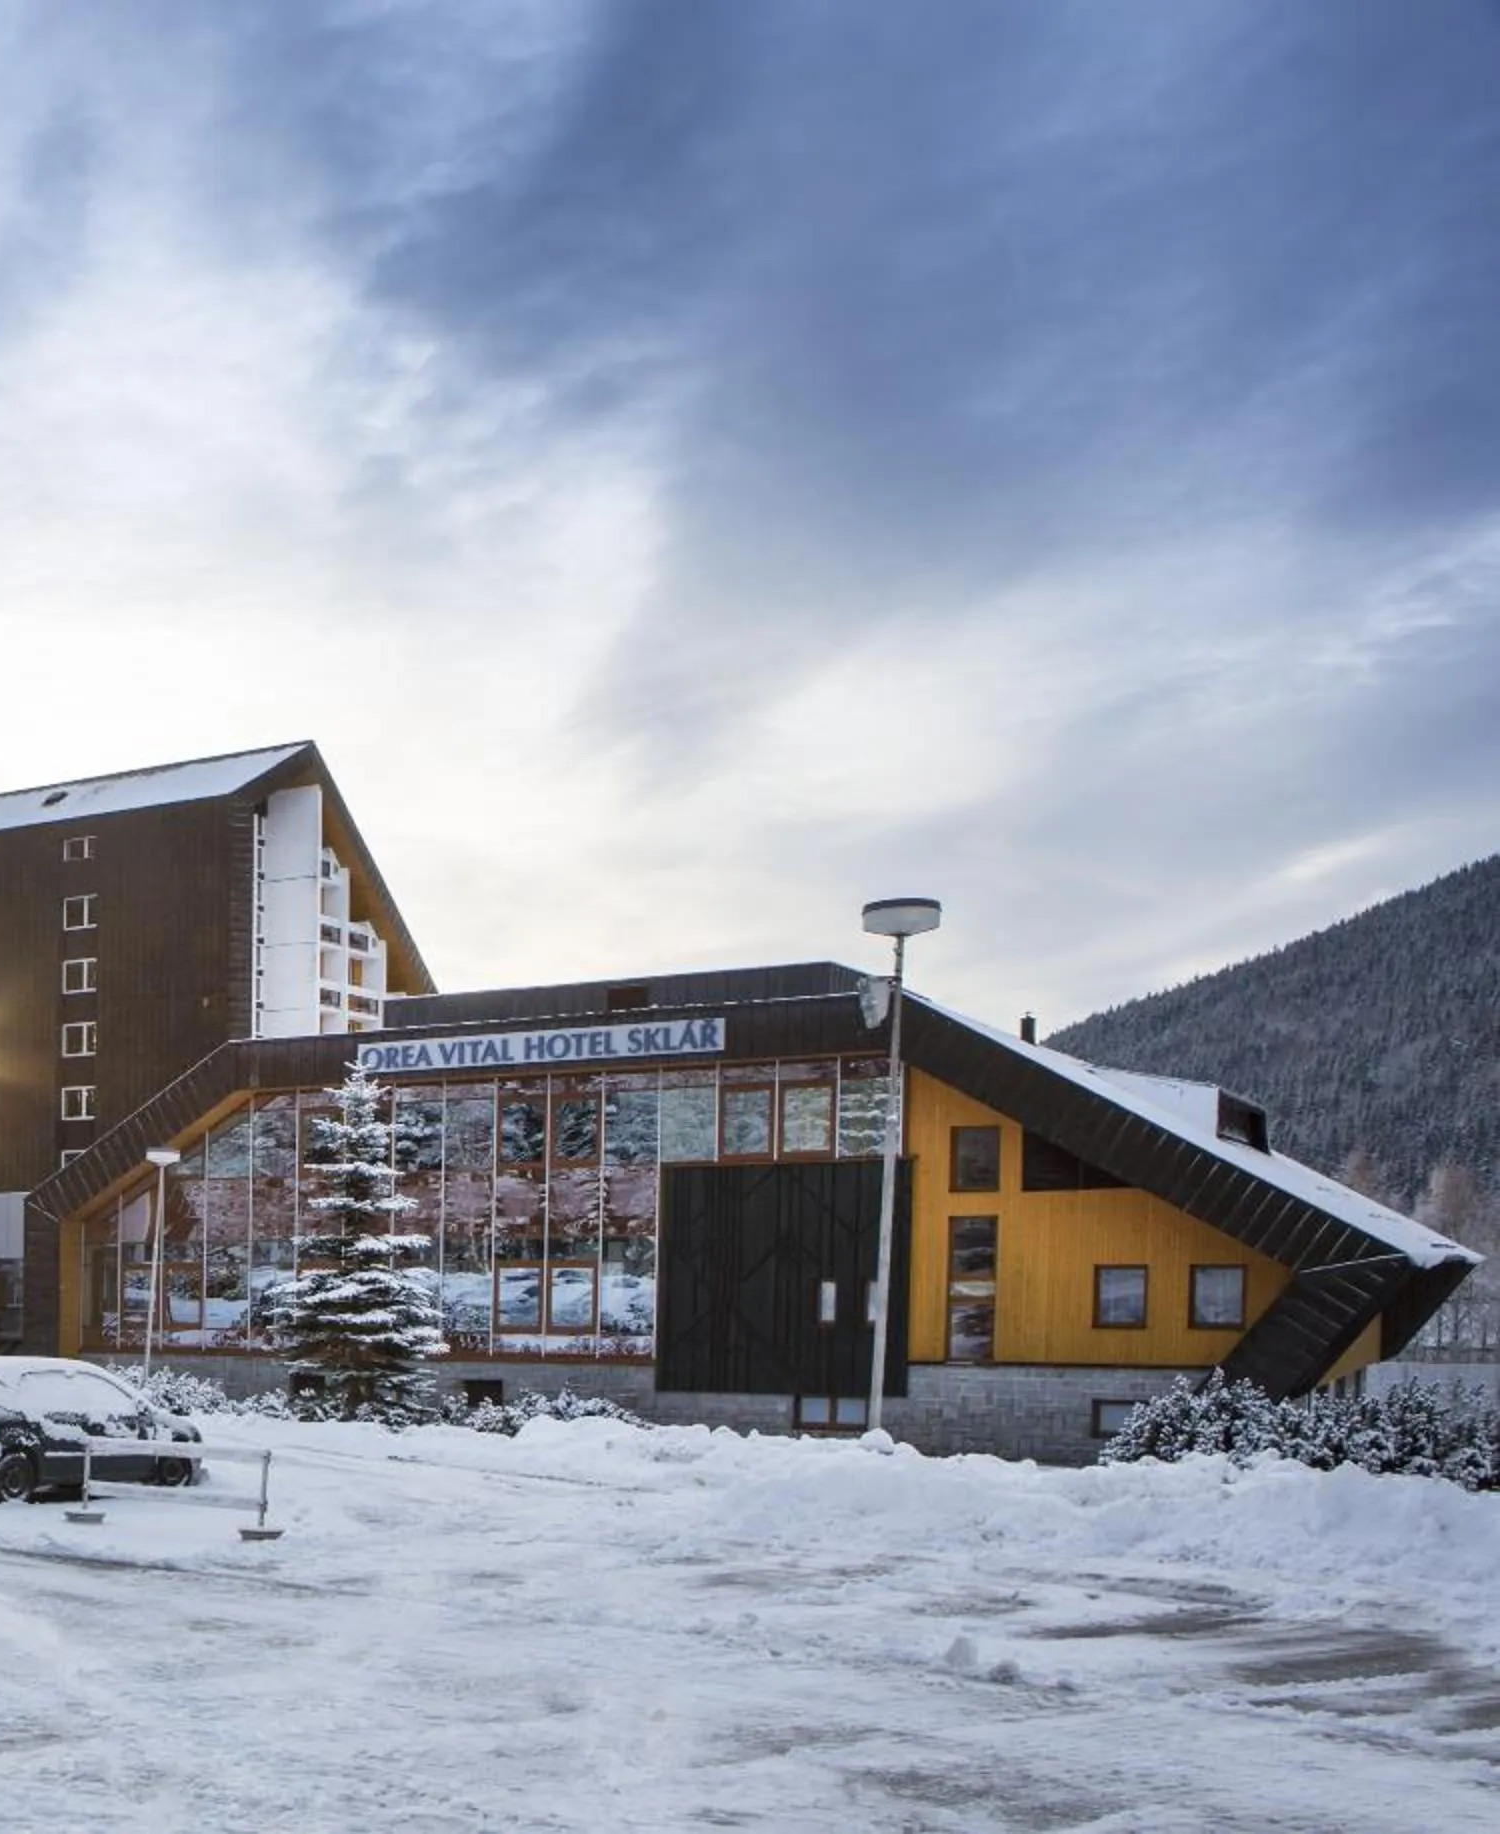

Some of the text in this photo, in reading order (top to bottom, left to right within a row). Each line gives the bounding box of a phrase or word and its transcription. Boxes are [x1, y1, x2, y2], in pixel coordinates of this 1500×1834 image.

[361, 1019, 718, 1070] OREA VITAL HOTEL SKLÁŘ
